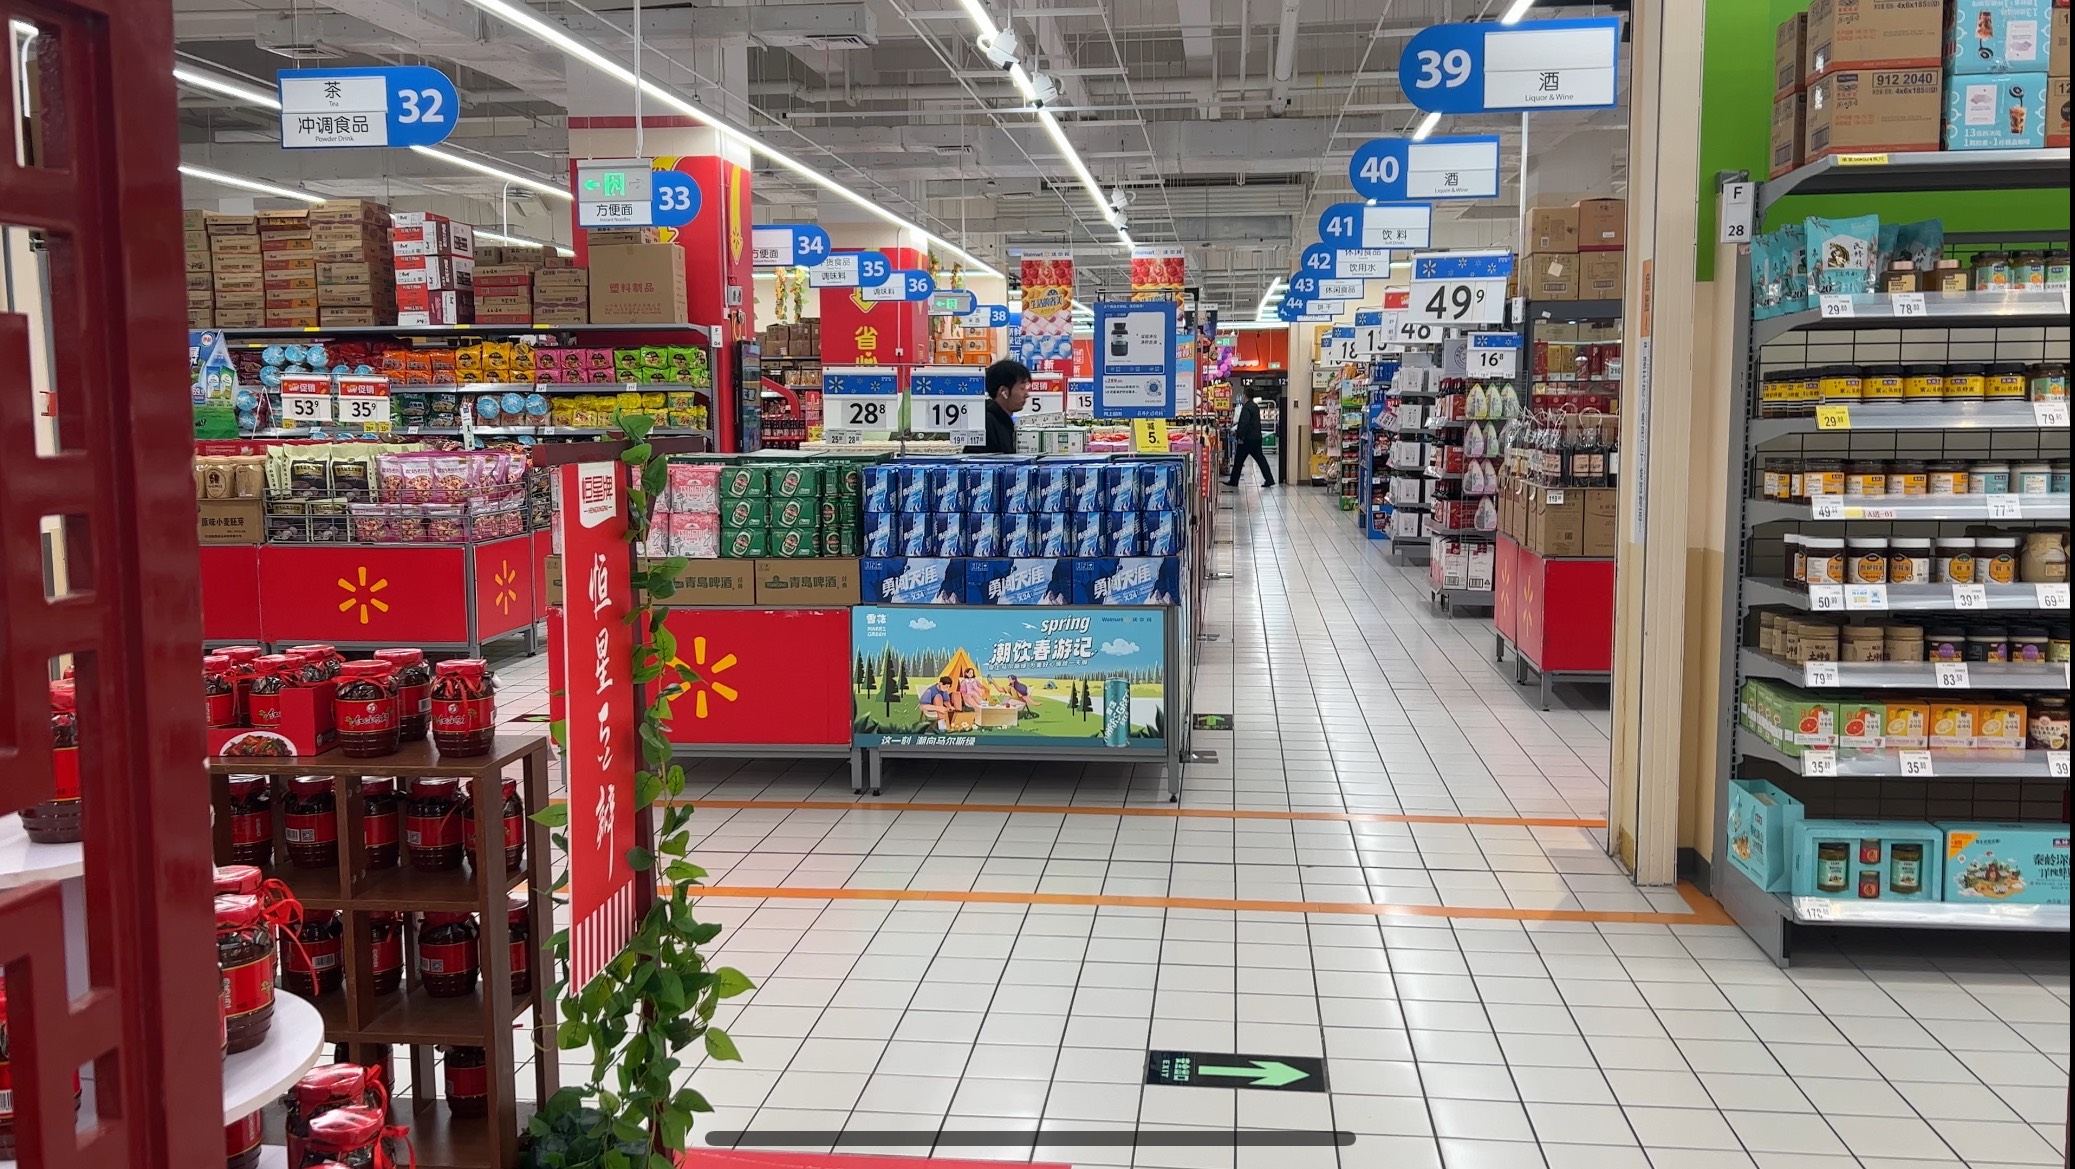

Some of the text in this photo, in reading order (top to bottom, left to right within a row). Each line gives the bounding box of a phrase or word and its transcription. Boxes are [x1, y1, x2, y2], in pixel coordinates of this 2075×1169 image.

[1415, 48, 1472, 89] 39
[1539, 71, 1560, 92] 酒
[1876, 72, 1933, 86] 912 2040
[324, 81, 341, 99] 茶
[1524, 92, 1574, 102] Liquor & Wine
[397, 88, 445, 124] 32
[298, 115, 369, 135] 冲调食品
[315, 135, 338, 143] Powder
[1359, 156, 1400, 184] 40
[1444, 172, 1459, 186] 酒
[658, 185, 691, 211] 33
[1733, 186, 1743, 199] F
[596, 203, 633, 217] 方便面
[1326, 216, 1354, 237] 41
[1728, 224, 1744, 237] 28
[1382, 229, 1408, 241] 饮料
[798, 235, 824, 255] 34
[1307, 252, 1331, 270] 42
[1349, 263, 1376, 273] 饮用水
[821, 271, 846, 280] 调味料
[863, 260, 885, 277] 35
[609, 282, 655, 294] 塑料制品
[873, 287, 895, 295] 调味料
[908, 277, 928, 292] 36
[1294, 278, 1315, 292] 43
[1325, 286, 1356, 294] 休闲食品
[1286, 297, 1304, 309] 44
[991, 310, 1007, 321] 38
[300, 383, 316, 393] 促销
[358, 384, 375, 394] 促销
[1031, 381, 1048, 391] 促销
[684, 576, 732, 589] 青岛啤酒
[789, 575, 837, 588] 青岛啤酒
[881, 565, 938, 599] 勇闯天涯
[987, 565, 1045, 599] 勇闯天涯
[1093, 565, 1151, 599] 勇闯天涯
[866, 613, 887, 625] 雪花
[1040, 613, 1091, 636] spring
[989, 637, 1095, 663] 潮饮春游记
[881, 735, 912, 746] 这一刻
[1161, 1059, 1170, 1078] EXIT
[1173, 1058, 1191, 1081] 安全出口
